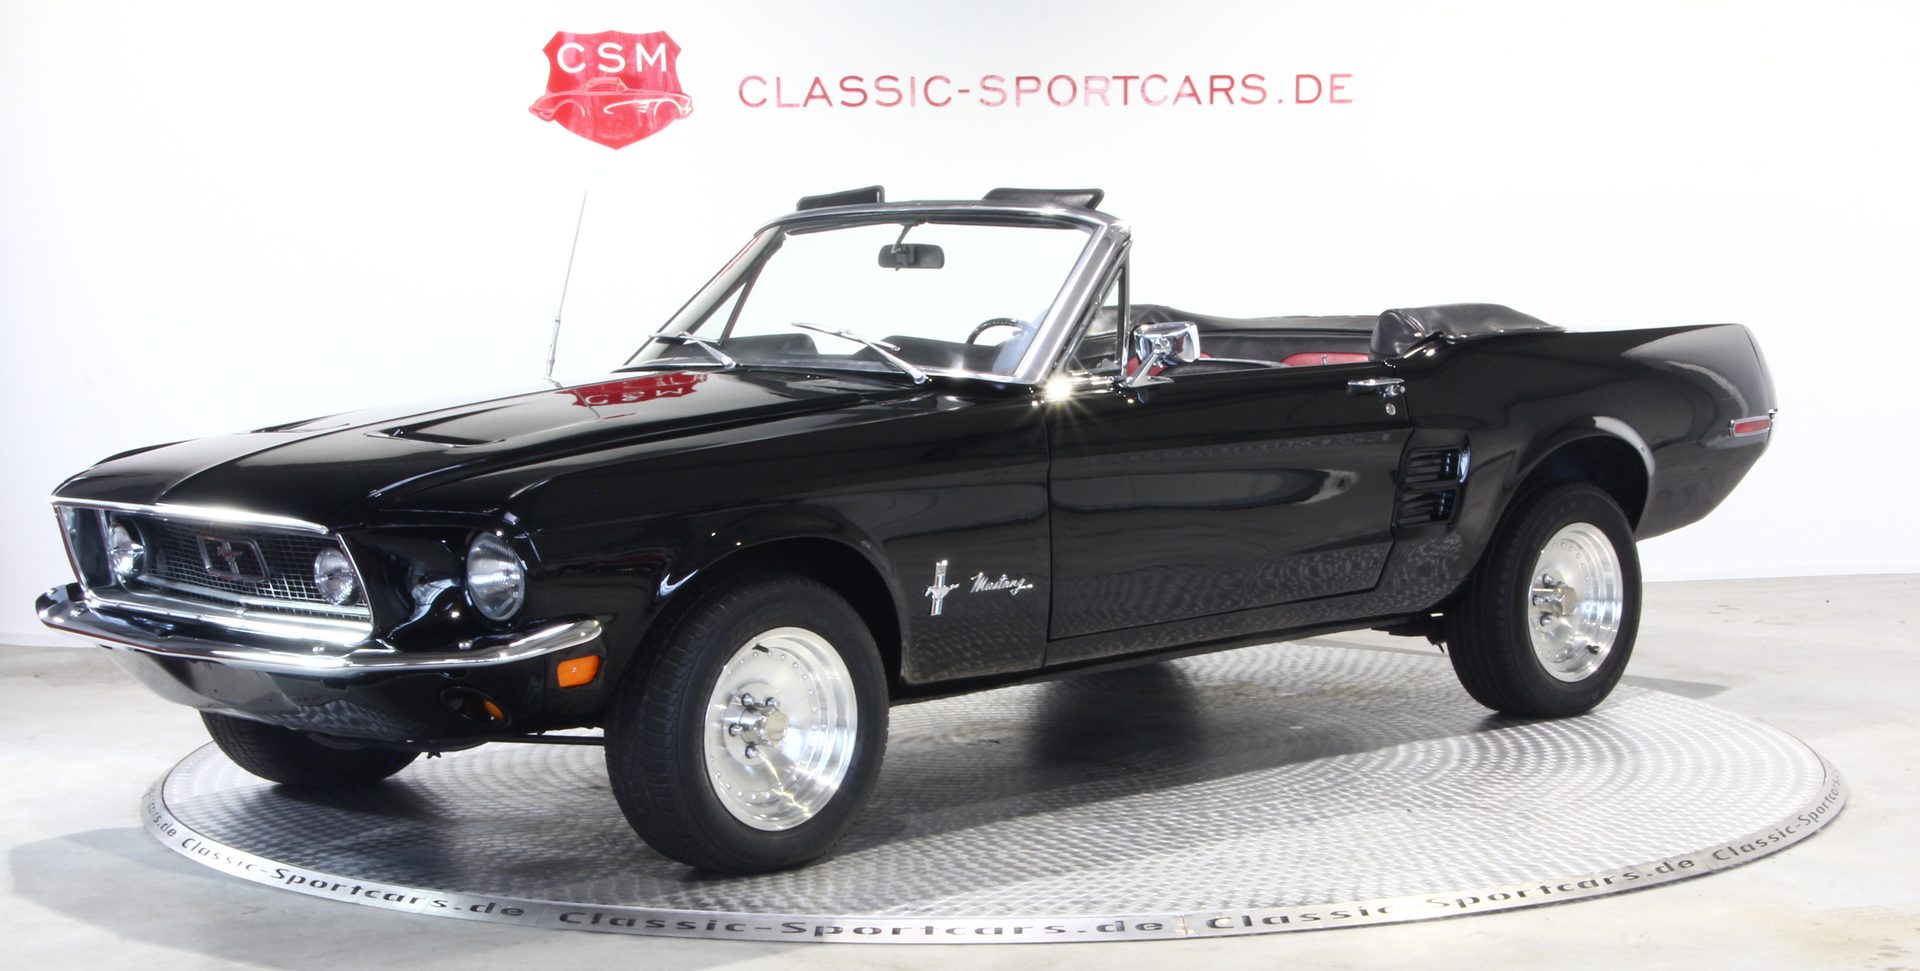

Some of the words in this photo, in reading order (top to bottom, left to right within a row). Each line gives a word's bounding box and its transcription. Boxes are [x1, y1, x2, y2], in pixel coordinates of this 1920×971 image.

[557, 42, 667, 73] CSM
[738, 73, 1353, 108] CLASSIC-SPORTCARS.DE
[969, 571, 1034, 596] Mustang
[181, 838, 525, 917] Classic-Sportcars.de
[558, 911, 1164, 938] Classic-Sportcars.de
